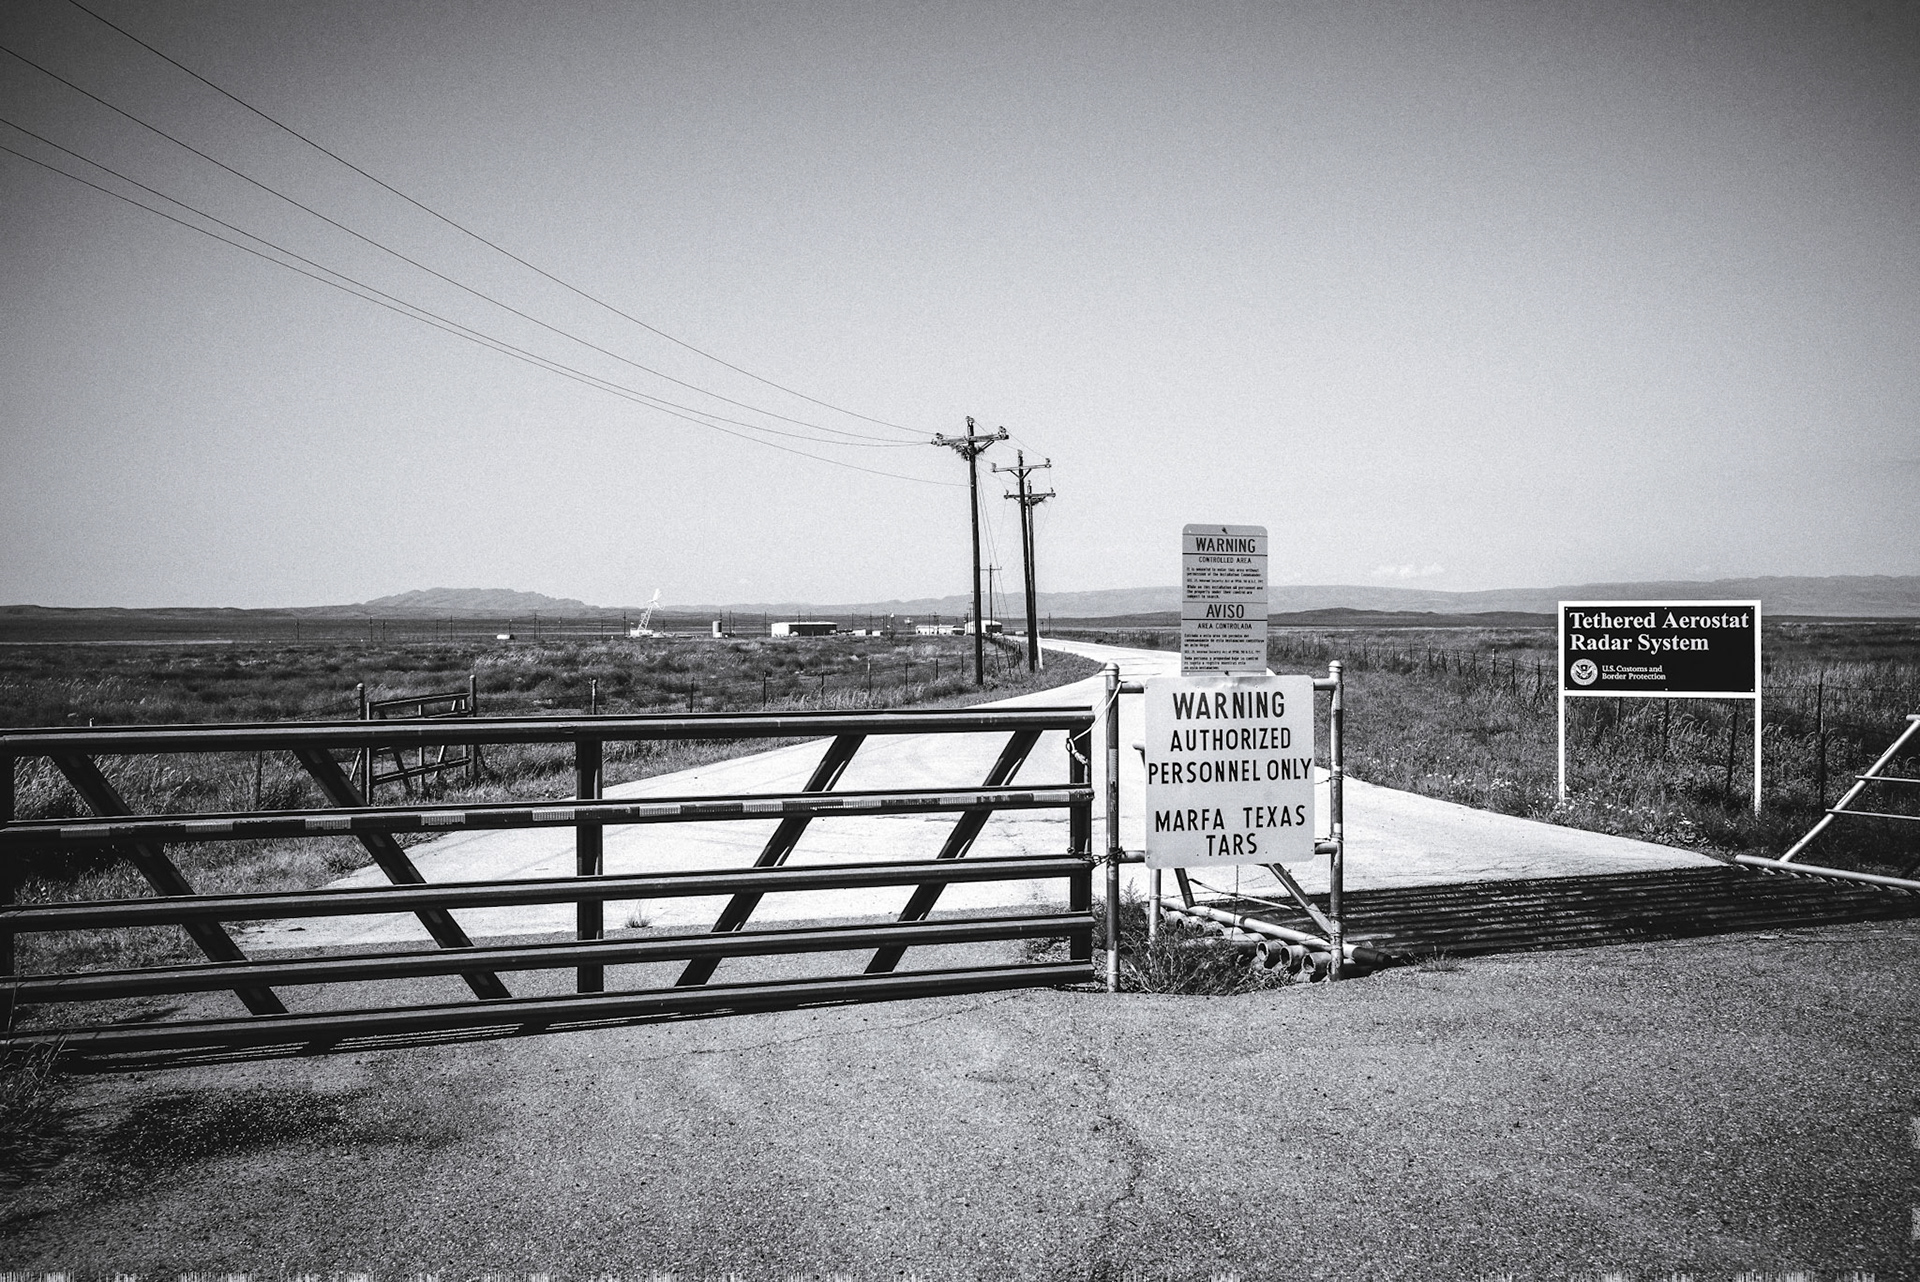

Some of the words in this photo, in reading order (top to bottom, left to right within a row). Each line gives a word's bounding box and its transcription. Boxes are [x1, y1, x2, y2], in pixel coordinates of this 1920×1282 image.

[1196, 537, 1255, 553] WARNING
[1206, 604, 1244, 618] AVISO
[1569, 612, 1656, 629] Tethered
[1663, 612, 1749, 628] Aerostat
[1570, 634, 1632, 651] Radar
[1638, 634, 1709, 655] System
[1173, 691, 1285, 719] WARNING
[1170, 728, 1291, 751] AUTHORIZED
[1148, 760, 1260, 784] PERSONNEL
[1267, 758, 1312, 781] ONLY
[1155, 809, 1225, 832] MARFA
[1243, 805, 1305, 828] TEXAS
[1206, 833, 1257, 856] TARS
